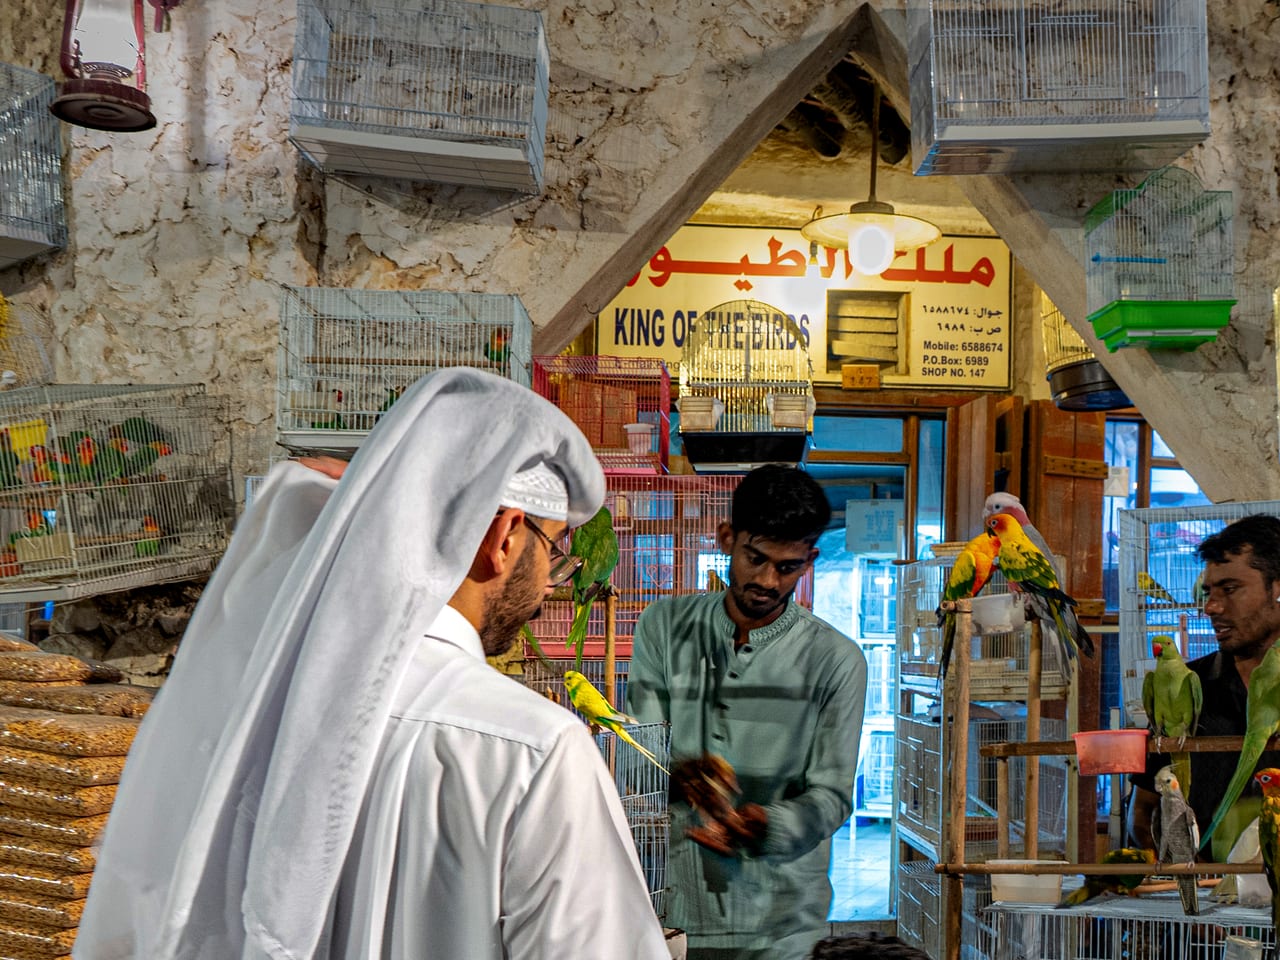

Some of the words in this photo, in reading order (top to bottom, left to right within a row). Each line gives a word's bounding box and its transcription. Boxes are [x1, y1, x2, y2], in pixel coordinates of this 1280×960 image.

[923, 305, 969, 315] ٦٥٨٨٦٧٤
[614, 308, 665, 348] KING
[704, 311, 746, 350] THE
[751, 313, 811, 351] BIRDS
[937, 322, 966, 331] ٦٩٨٩
[923, 340, 959, 351] Mobile:
[961, 342, 1004, 352] 6588674
[923, 354, 962, 365] P.O.Box:
[965, 356, 989, 366] 6989
[922, 367, 947, 376] SHOP
[950, 368, 966, 377] NO.
[970, 369, 986, 377] 147
